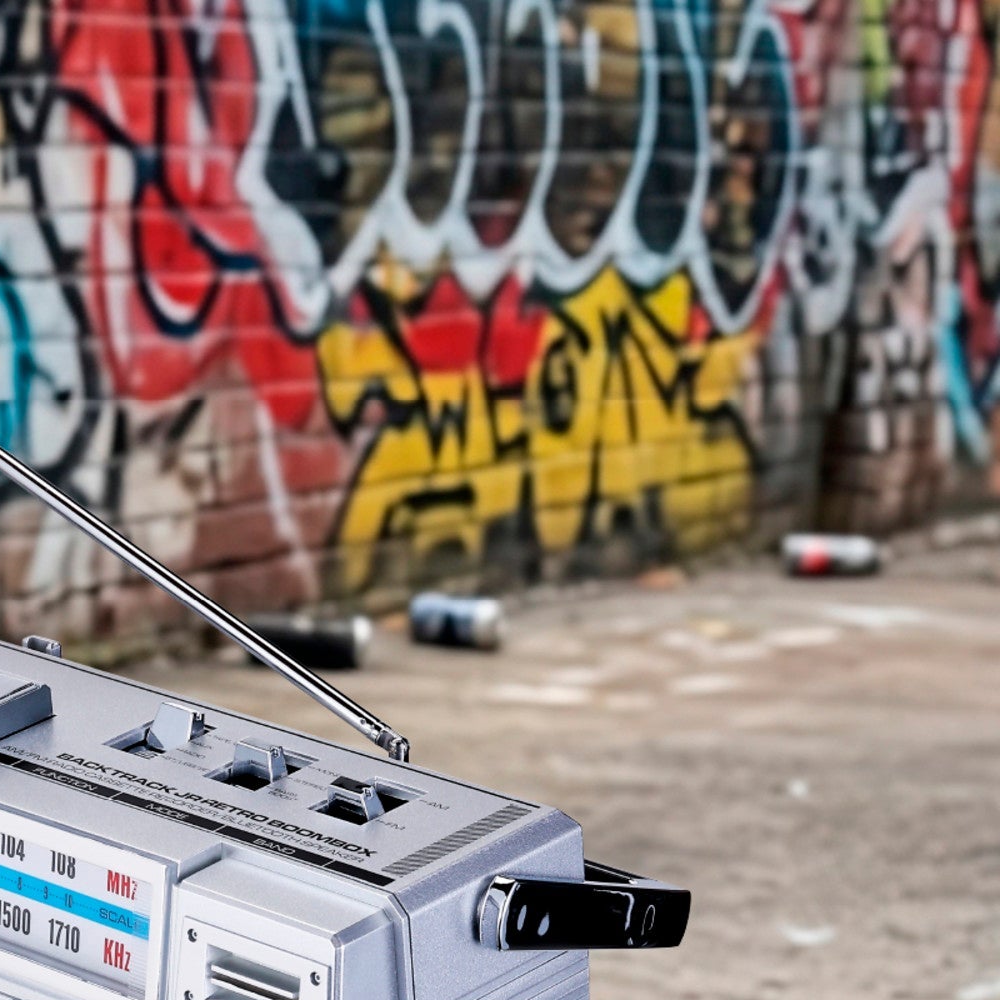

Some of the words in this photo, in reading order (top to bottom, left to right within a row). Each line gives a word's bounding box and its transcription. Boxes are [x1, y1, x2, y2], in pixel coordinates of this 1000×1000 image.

[201, 799, 269, 822] RETRO
[267, 819, 378, 857] BOOMBOX
[1, 832, 26, 862] 104
[51, 849, 76, 880] 108
[253, 838, 296, 856] BAND
[64, 893, 73, 909] 10
[48, 918, 80, 953] 1710
